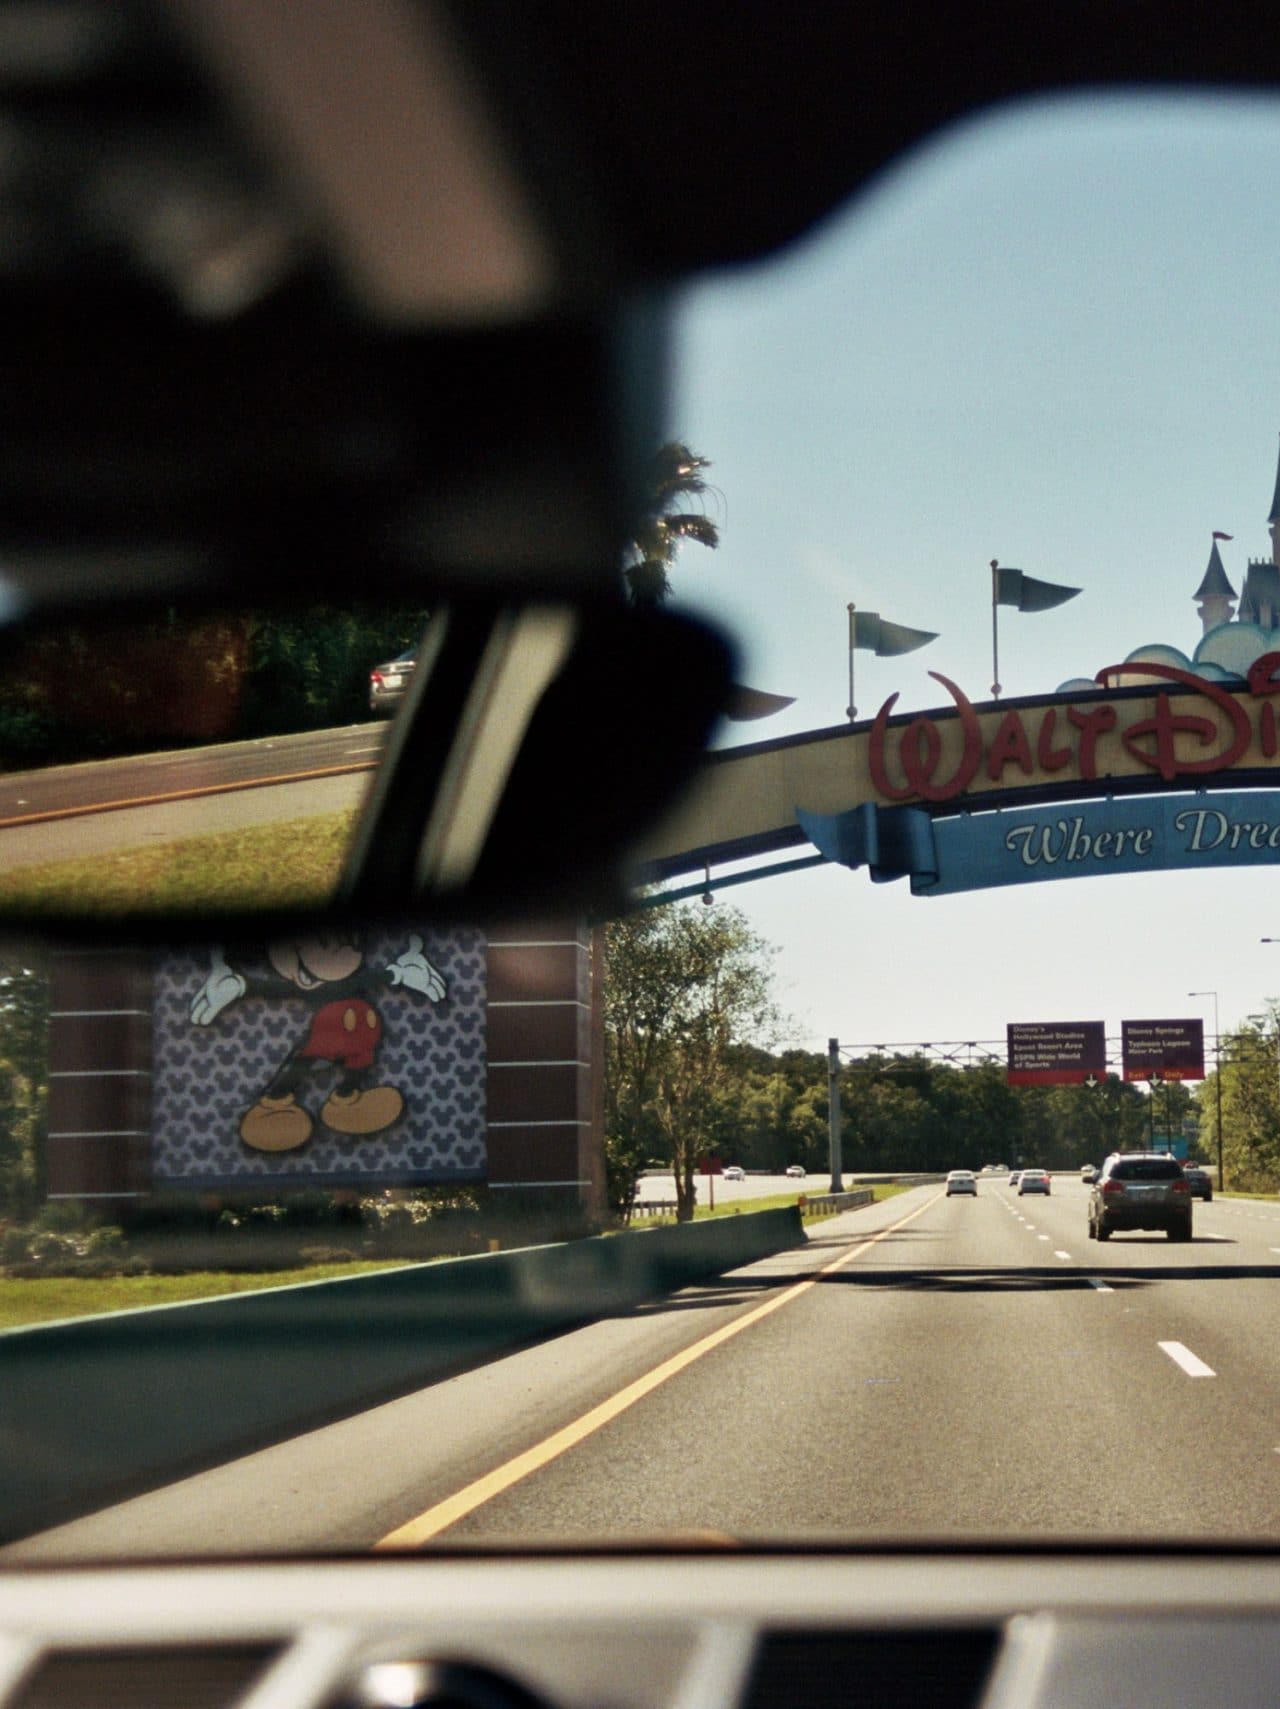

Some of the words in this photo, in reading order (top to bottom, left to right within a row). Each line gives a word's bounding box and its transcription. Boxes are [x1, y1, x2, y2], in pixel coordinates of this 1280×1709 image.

[1006, 817, 1153, 866] Where
[1154, 1027, 1184, 1035] Springs
[1057, 1052, 1081, 1060] World
[1025, 1061, 1050, 1069] Sports
